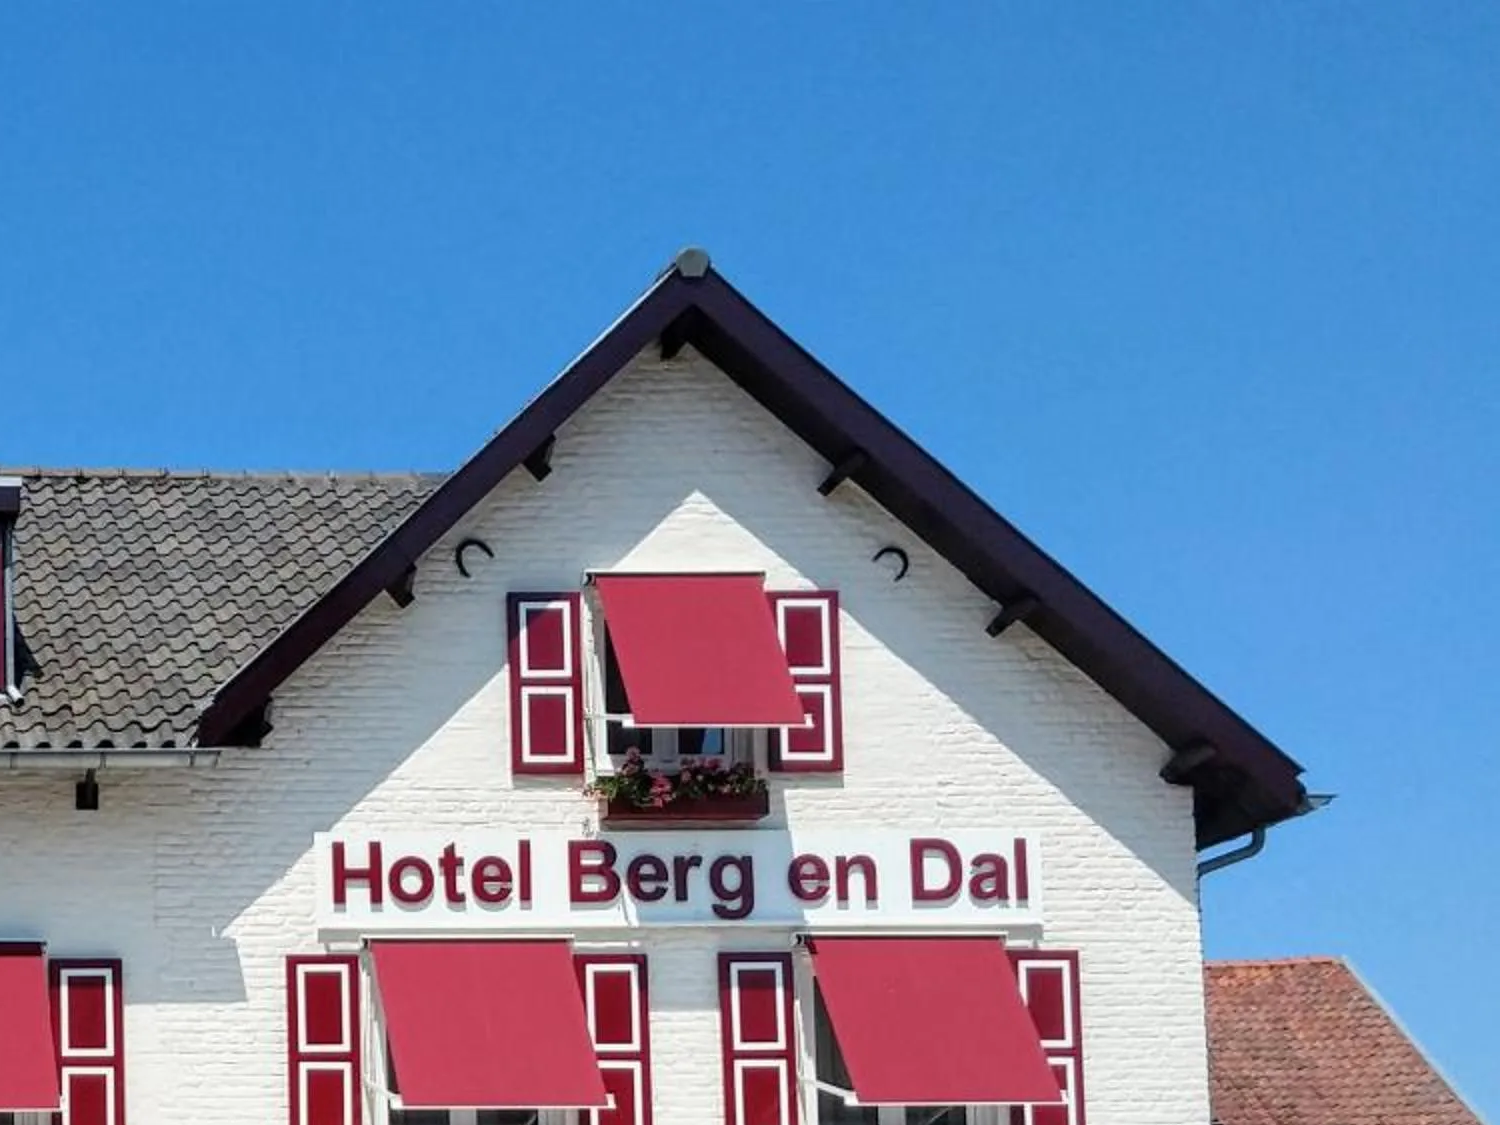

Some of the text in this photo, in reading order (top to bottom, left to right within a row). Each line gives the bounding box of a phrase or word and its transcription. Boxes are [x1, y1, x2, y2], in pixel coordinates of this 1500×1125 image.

[331, 837, 1028, 919] Hotel Berg en Dal
